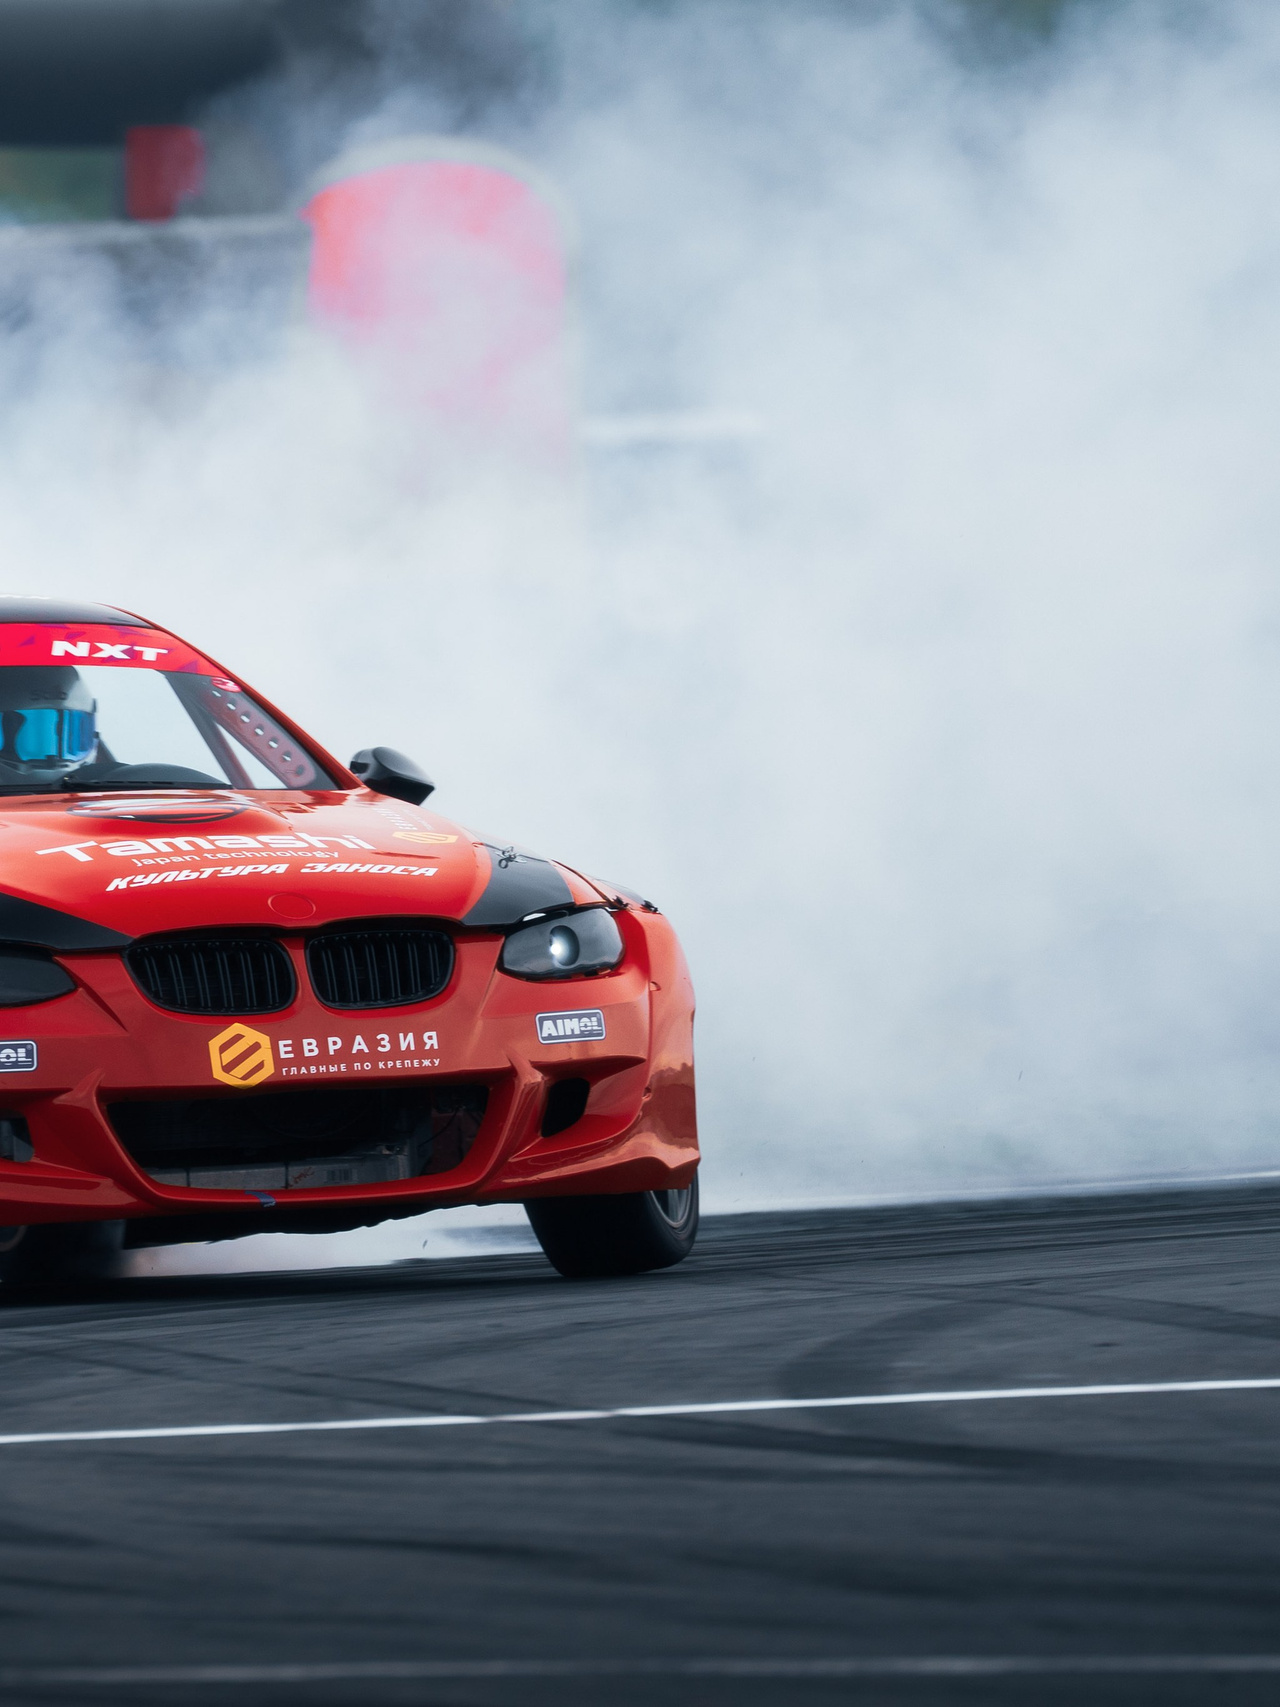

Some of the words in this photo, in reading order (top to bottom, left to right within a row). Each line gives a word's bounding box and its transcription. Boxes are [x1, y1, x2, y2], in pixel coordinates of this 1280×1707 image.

[51, 640, 169, 661] NXT
[35, 832, 376, 864] Tamashi
[131, 853, 201, 867] Japan
[203, 848, 339, 861] technology
[105, 863, 286, 892] КУЛЬТУРА
[300, 862, 440, 877] ЗАНОСА
[541, 1017, 602, 1037] AIMOL
[278, 1031, 439, 1058] ЕВРАЗИЯ
[282, 1063, 347, 1076] ГЛАВНЫЕ
[354, 1061, 372, 1071] ПО
[378, 1058, 441, 1069] КРЕПЕЖУ
